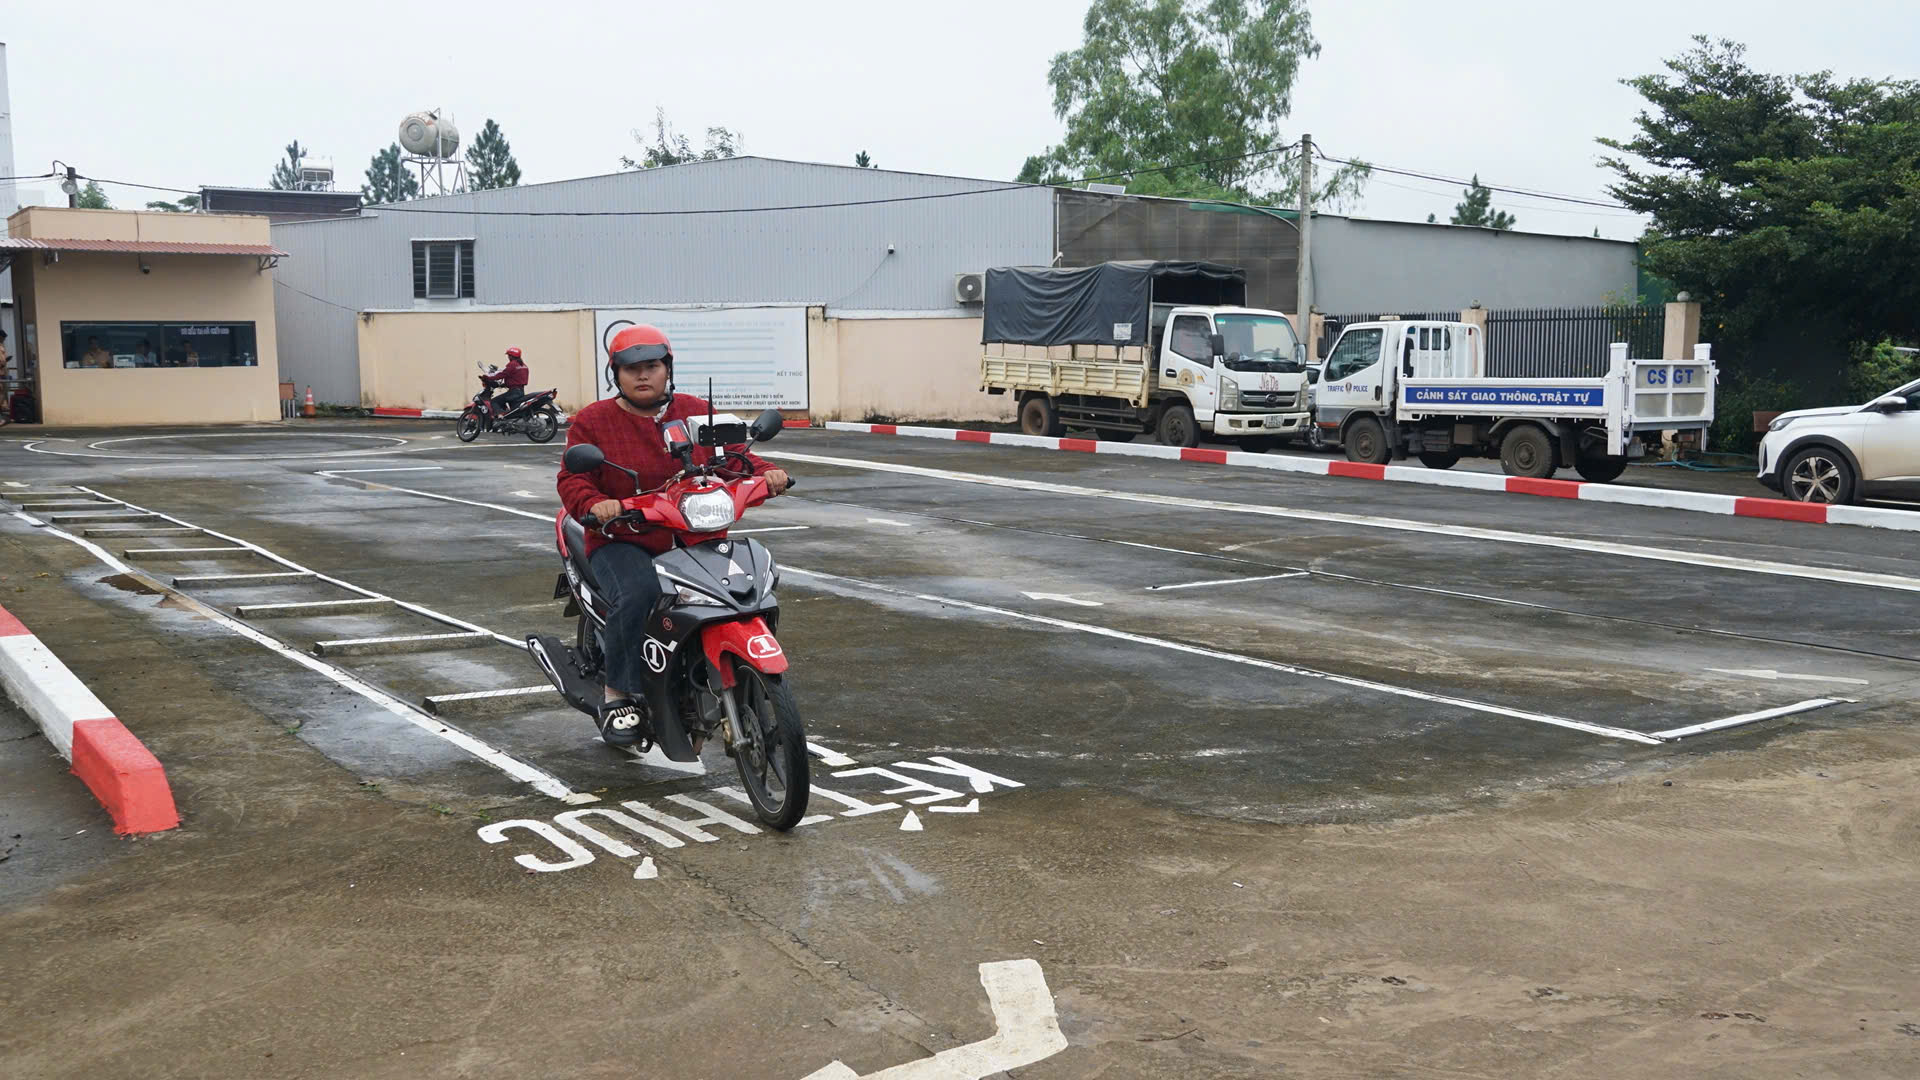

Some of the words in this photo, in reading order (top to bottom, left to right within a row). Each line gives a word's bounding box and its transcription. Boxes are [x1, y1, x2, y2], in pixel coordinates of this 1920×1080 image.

[1352, 385, 1369, 393] POLICE
[1416, 388, 1444, 400] CẢNH
[1447, 389, 1468, 401] SÁT
[1471, 392, 1497, 402] GIAO
[1573, 391, 1591, 405] TỰ
[809, 756, 1026, 832] KẾT
